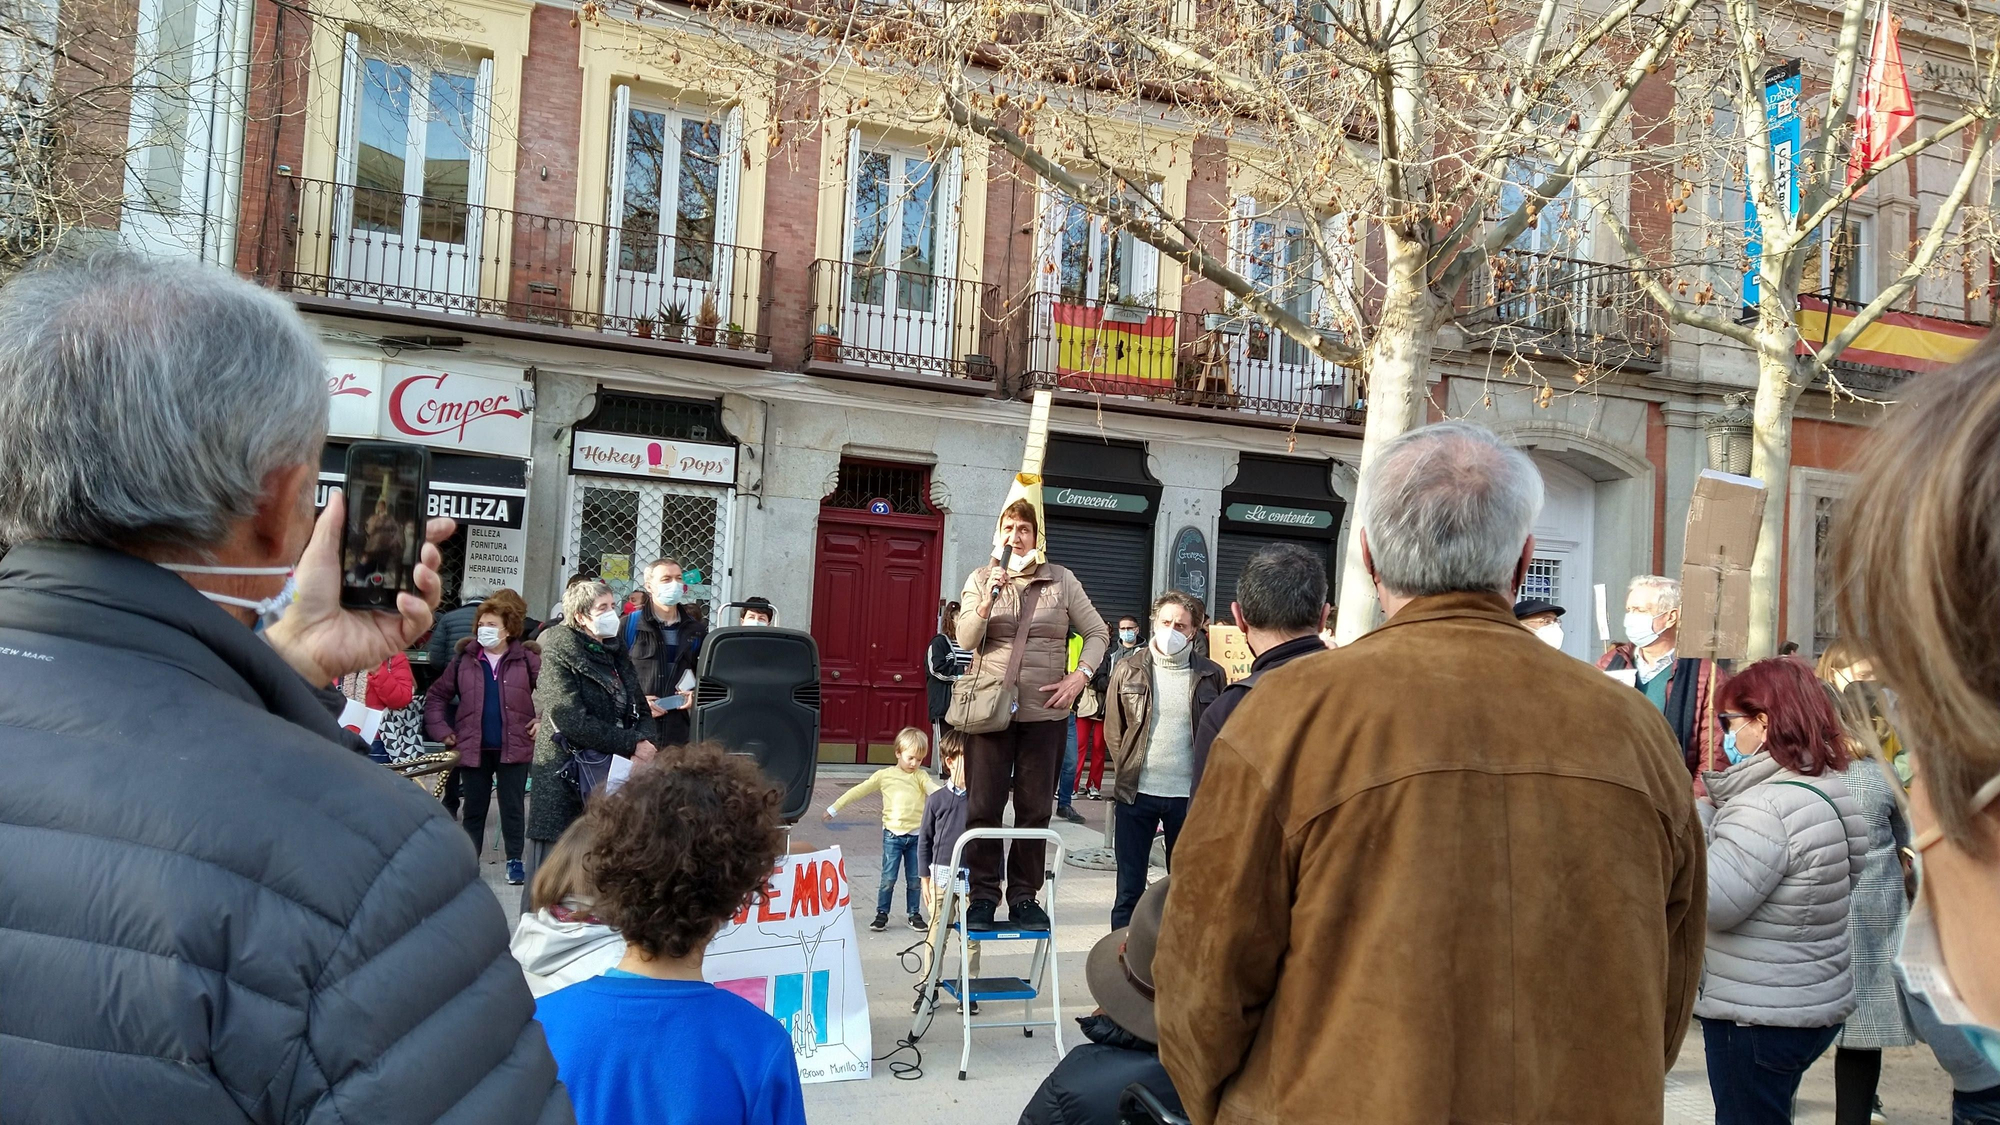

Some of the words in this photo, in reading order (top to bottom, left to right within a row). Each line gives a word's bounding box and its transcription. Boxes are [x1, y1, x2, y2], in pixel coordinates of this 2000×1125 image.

[388, 372, 524, 444] Comper
[579, 445, 643, 469] Hokey
[680, 456, 724, 475] Pops
[1056, 489, 1118, 509] Cervecería
[427, 494, 509, 522] BELLEZA
[876, 503, 884, 513] 3
[1245, 505, 1267, 521] La
[1268, 511, 1316, 525] contenta
[471, 528, 500, 538] BELLEZA
[470, 540, 507, 550] FORNITURA
[470, 553, 519, 563] APARATOLOGIA
[468, 565, 518, 575] HERRAMIENTAS
[488, 578, 506, 586] PARA
[21, 651, 55, 661] MARC
[830, 1061, 857, 1075] Murillo
[858, 1061, 869, 1072] 37
